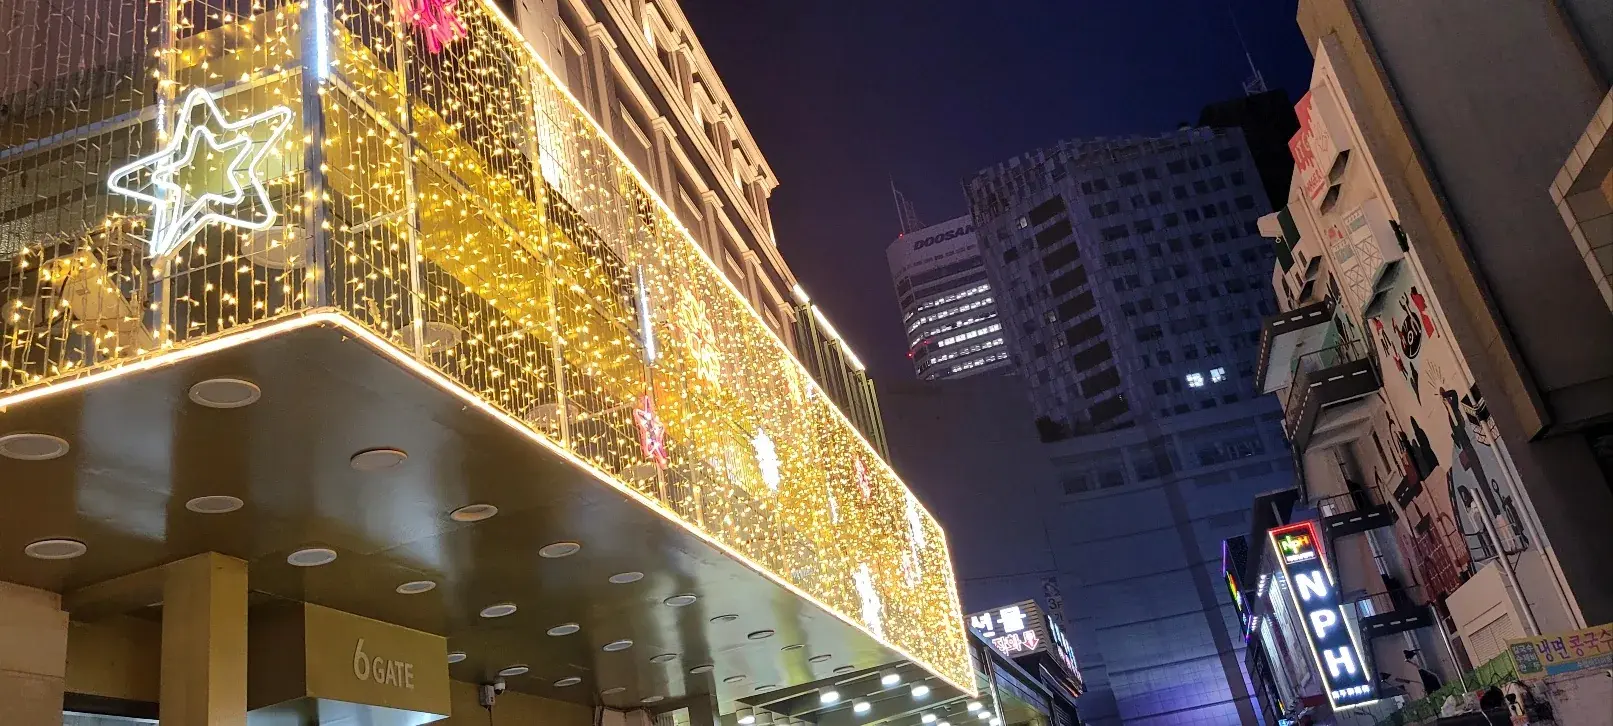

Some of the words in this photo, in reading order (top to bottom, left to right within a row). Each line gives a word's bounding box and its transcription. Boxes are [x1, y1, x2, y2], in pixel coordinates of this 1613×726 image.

[913, 225, 975, 251] DOOSAN
[1048, 598, 1063, 610] 3F
[1295, 571, 1356, 677] NPH
[1536, 637, 1570, 662] 냉면
[1570, 629, 1613, 656] 콩국수
[353, 638, 370, 680] 6
[372, 656, 415, 689] GATE
